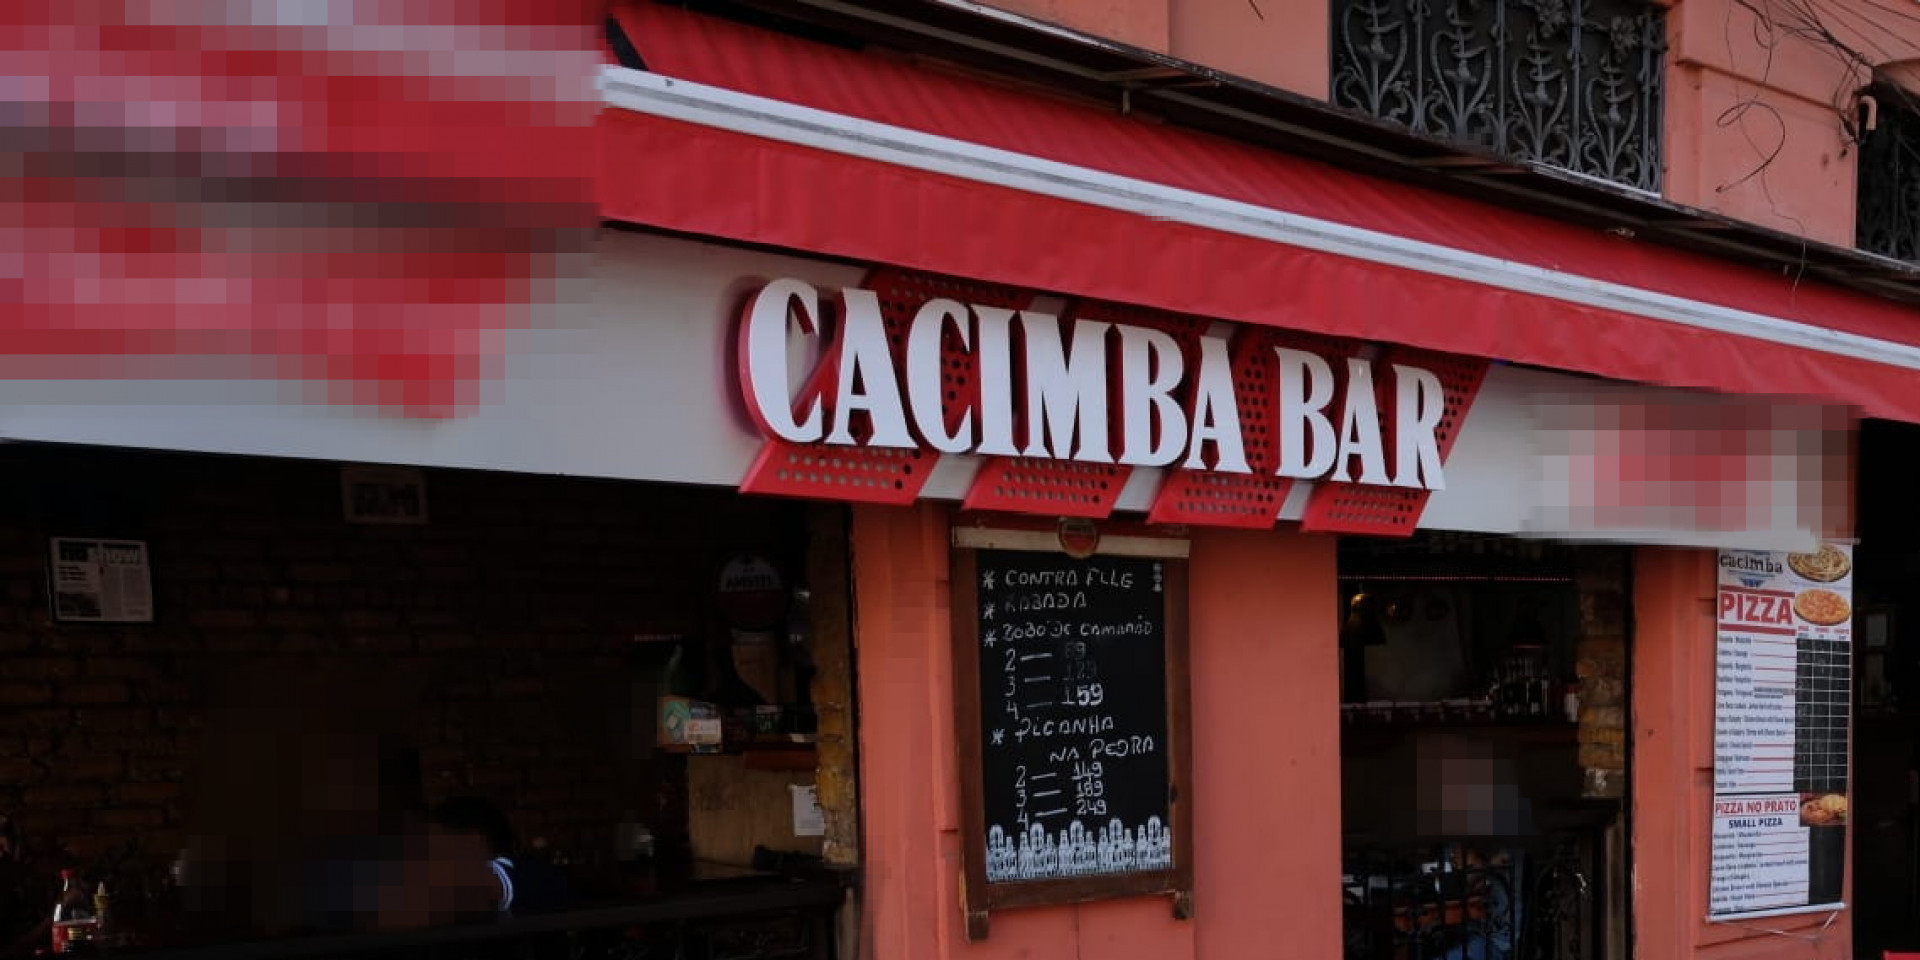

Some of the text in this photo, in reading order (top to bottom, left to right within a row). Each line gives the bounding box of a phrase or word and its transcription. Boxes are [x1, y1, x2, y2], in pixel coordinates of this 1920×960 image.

[743, 277, 1446, 491] CACIMBA BAR
[1719, 553, 1783, 574] cacimba
[1005, 569, 1079, 587] CONTRA
[1719, 591, 1793, 625] PIZZA
[1004, 648, 1016, 671] 2
[1004, 675, 1016, 697] 3
[1005, 682, 1104, 720] 4 159
[1015, 714, 1114, 743] PICANHA
[1050, 735, 1154, 763] NA PEDRA
[1015, 761, 1103, 789] 2 149
[1016, 789, 1027, 808] 3
[1715, 799, 1796, 815] PIZZA NO PRATO
[1017, 799, 1107, 831] 4 249
[1728, 816, 1783, 829] SMALL PIZZA
